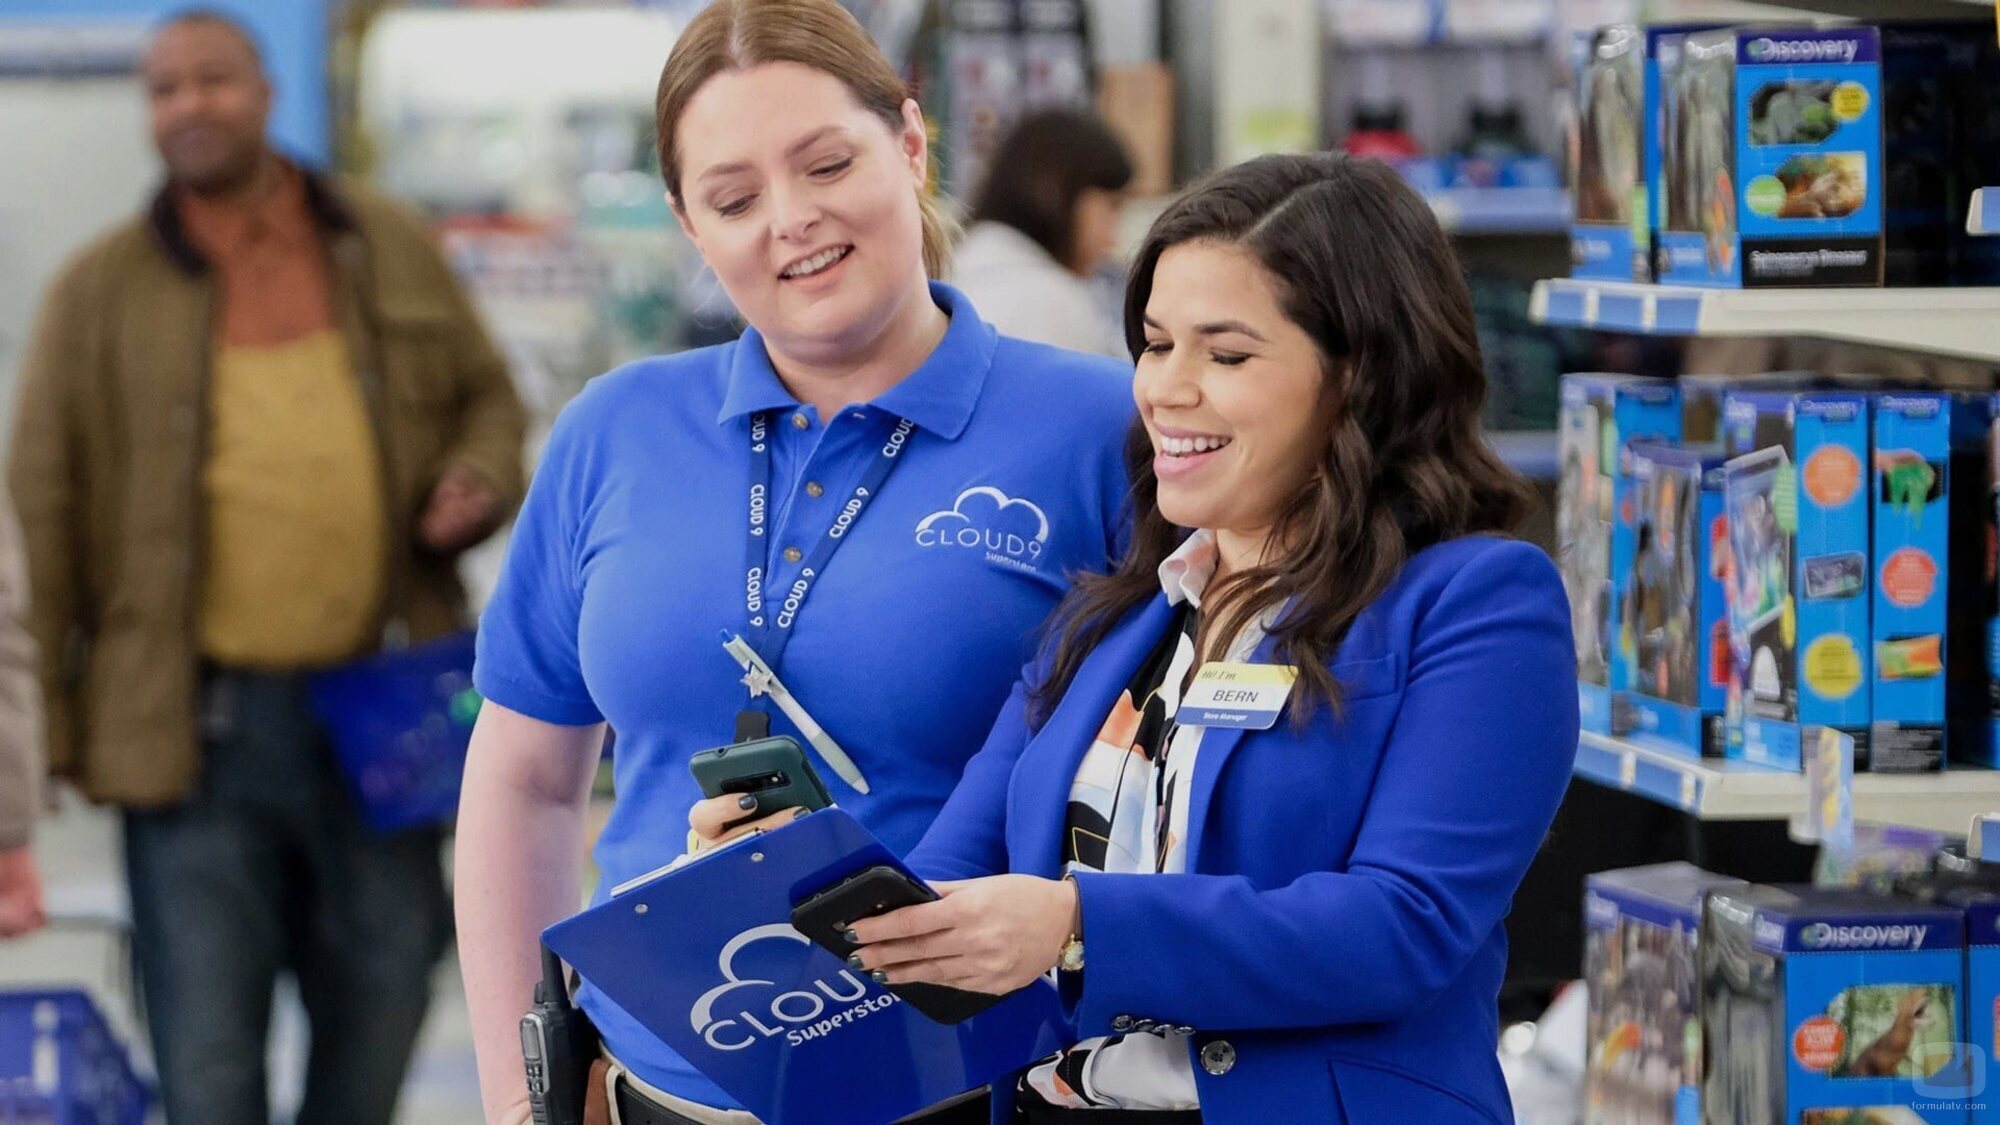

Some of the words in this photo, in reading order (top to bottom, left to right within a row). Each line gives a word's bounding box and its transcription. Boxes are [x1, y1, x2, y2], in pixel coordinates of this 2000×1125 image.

[1757, 37, 1858, 64] Discovery
[752, 412, 765, 441] OUD
[752, 443, 766, 453] 9
[750, 484, 765, 525] CLOUD
[829, 498, 862, 538] CLOUD
[856, 487, 869, 497] 9
[750, 527, 764, 536] 9
[747, 567, 762, 612] CLOUD
[777, 579, 808, 628] CLOUD
[802, 568, 815, 577] 9
[749, 616, 764, 627] 9
[1212, 689, 1259, 703] BERN
[1813, 922, 1927, 952] Discovery
[704, 968, 867, 1051] CLOU
[786, 992, 901, 1047] Supersto
